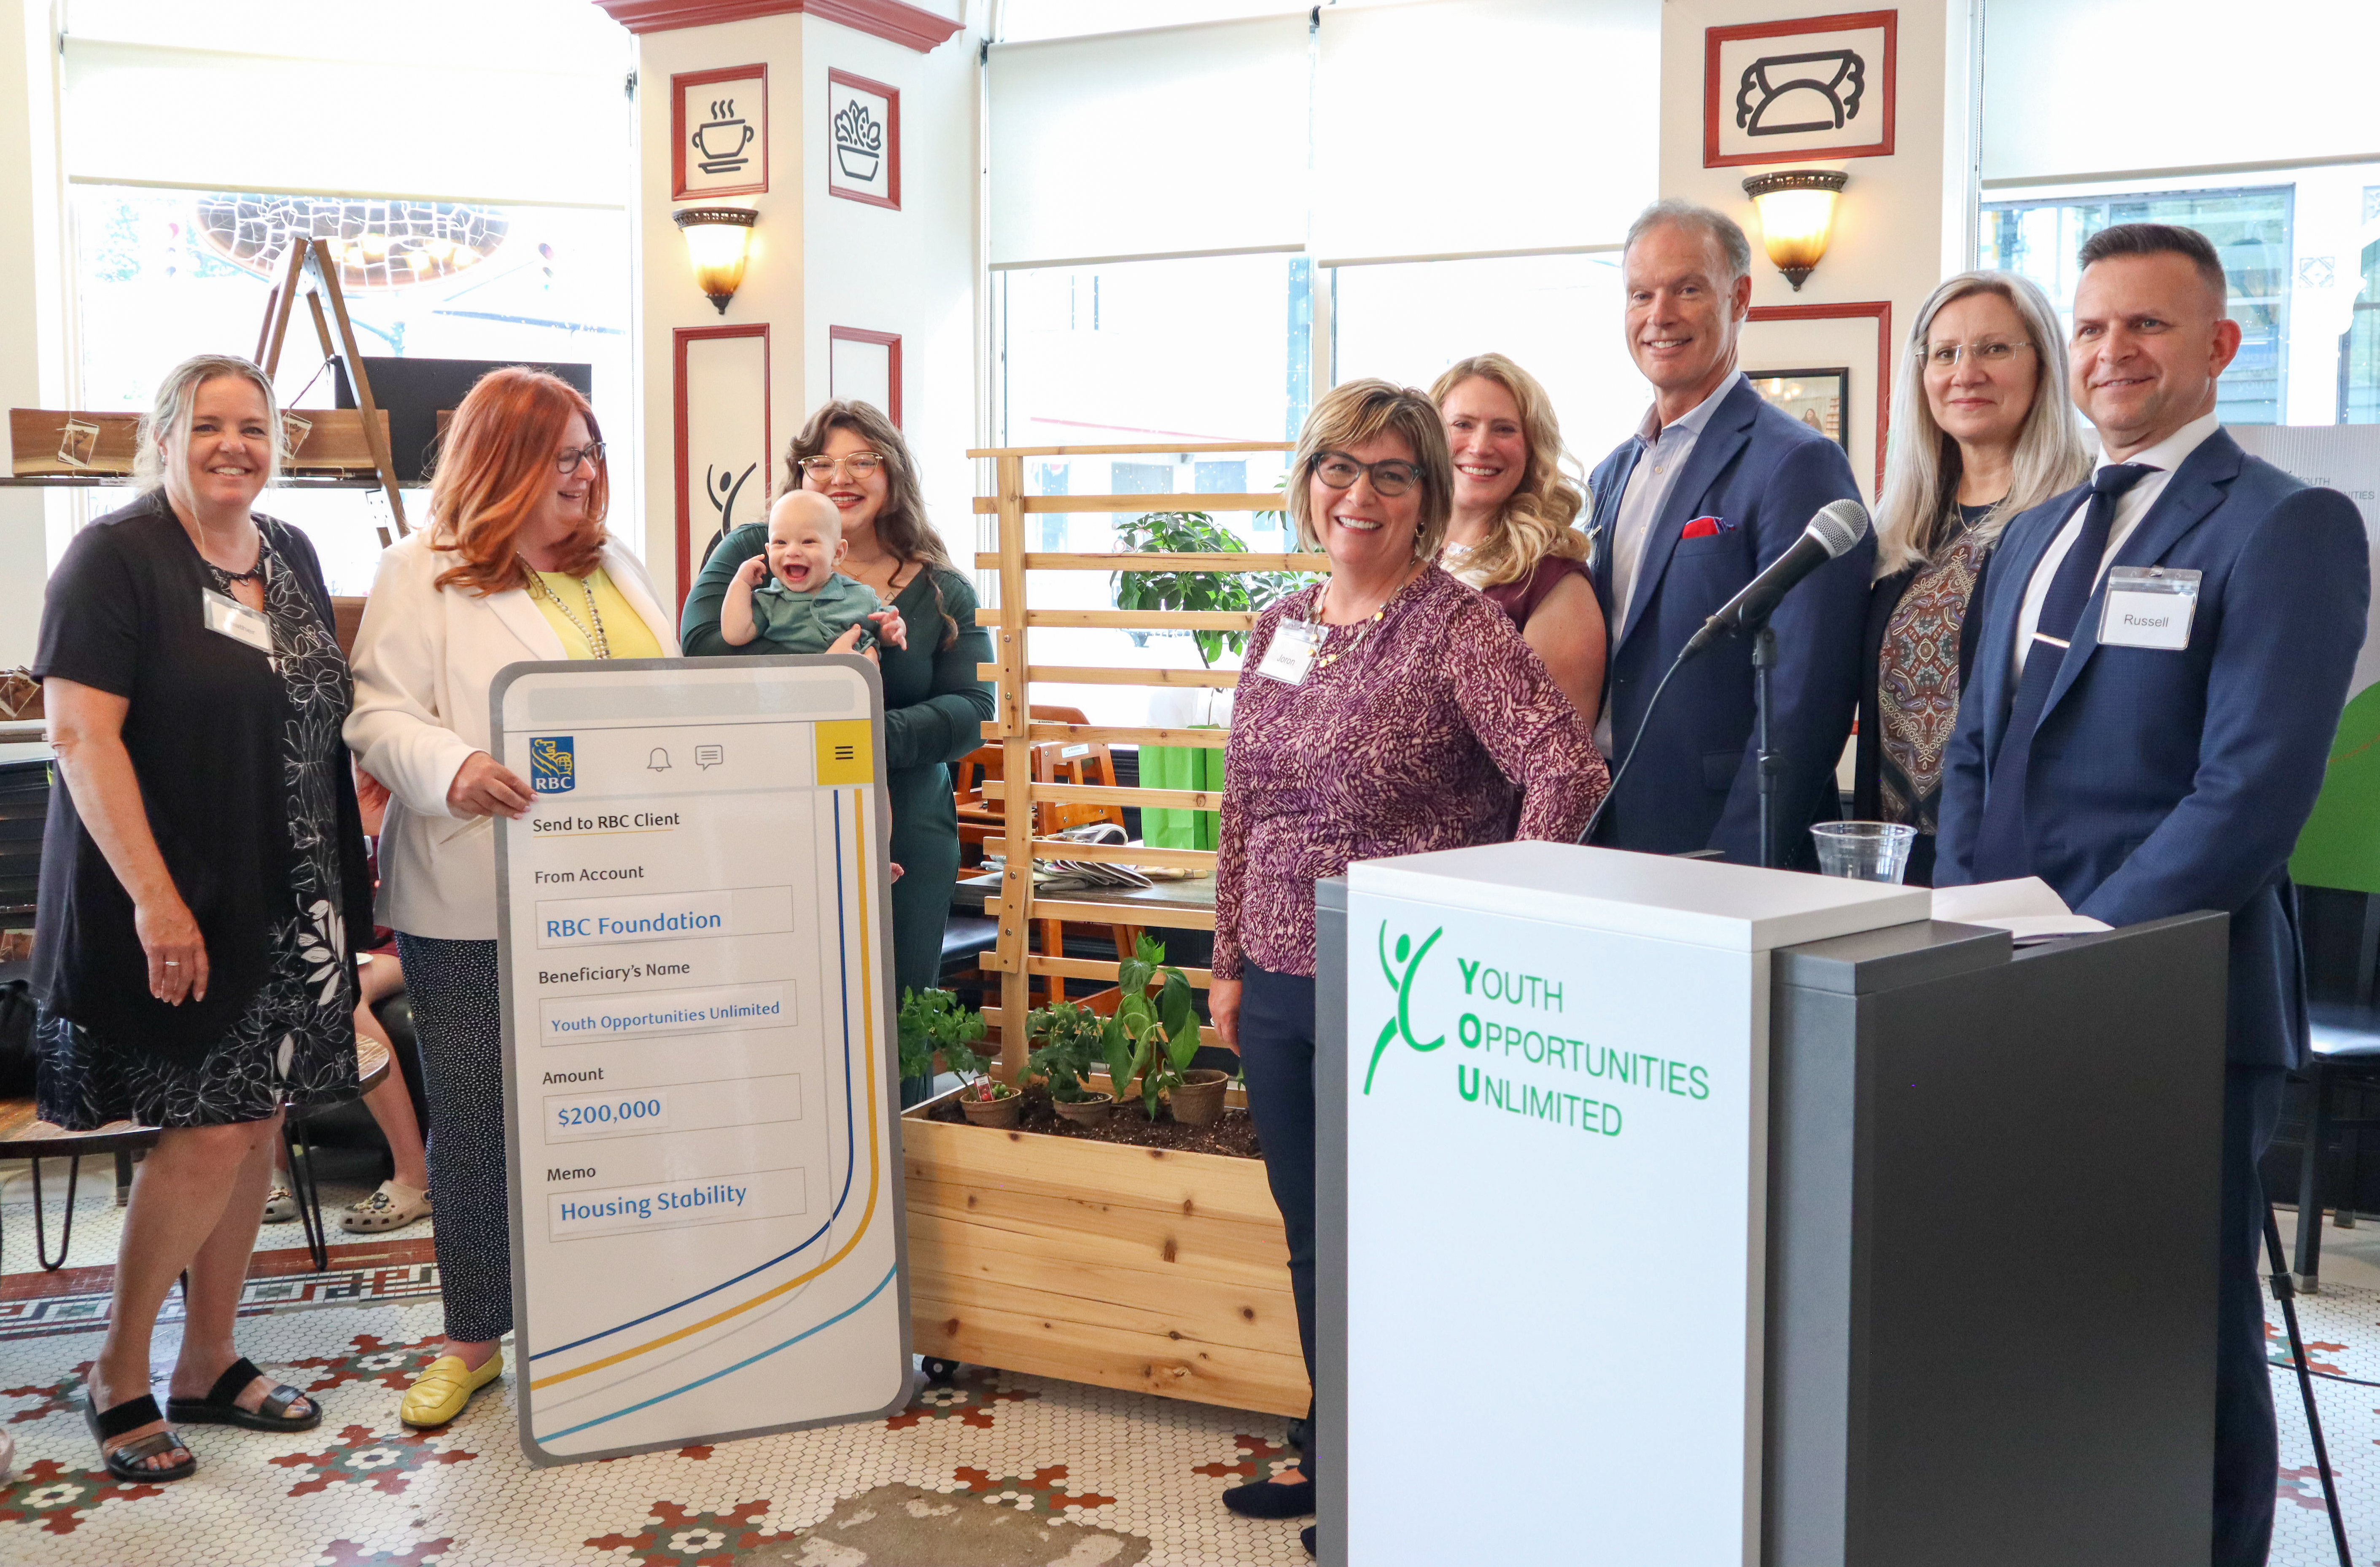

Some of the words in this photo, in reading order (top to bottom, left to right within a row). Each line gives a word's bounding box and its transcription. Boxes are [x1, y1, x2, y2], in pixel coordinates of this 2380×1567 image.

[2124, 615, 2168, 627] Russell
[536, 777, 571, 789] RBC
[533, 817, 571, 832] Send
[578, 818, 592, 829] to
[598, 815, 629, 828] RBC
[635, 813, 680, 826] Client
[535, 871, 574, 884] From
[580, 866, 644, 881] Account
[547, 919, 590, 937] RBC
[598, 911, 720, 934] Foundation
[539, 965, 641, 984] Beneficiary's
[646, 962, 689, 976] Name
[1458, 958, 1562, 1013] YOUTH
[552, 1016, 595, 1032] Youth
[601, 1009, 705, 1029] Opportunities
[710, 1001, 779, 1019] Unlimited
[1459, 1013, 1709, 1100] OPPORTUNITIES
[543, 1068, 603, 1084] Amount
[1459, 1064, 1623, 1136] UNLIMITED
[558, 1099, 660, 1127] $200,000
[548, 1167, 595, 1181] Memo
[562, 1197, 651, 1220] Housing
[658, 1185, 746, 1210] Stability
